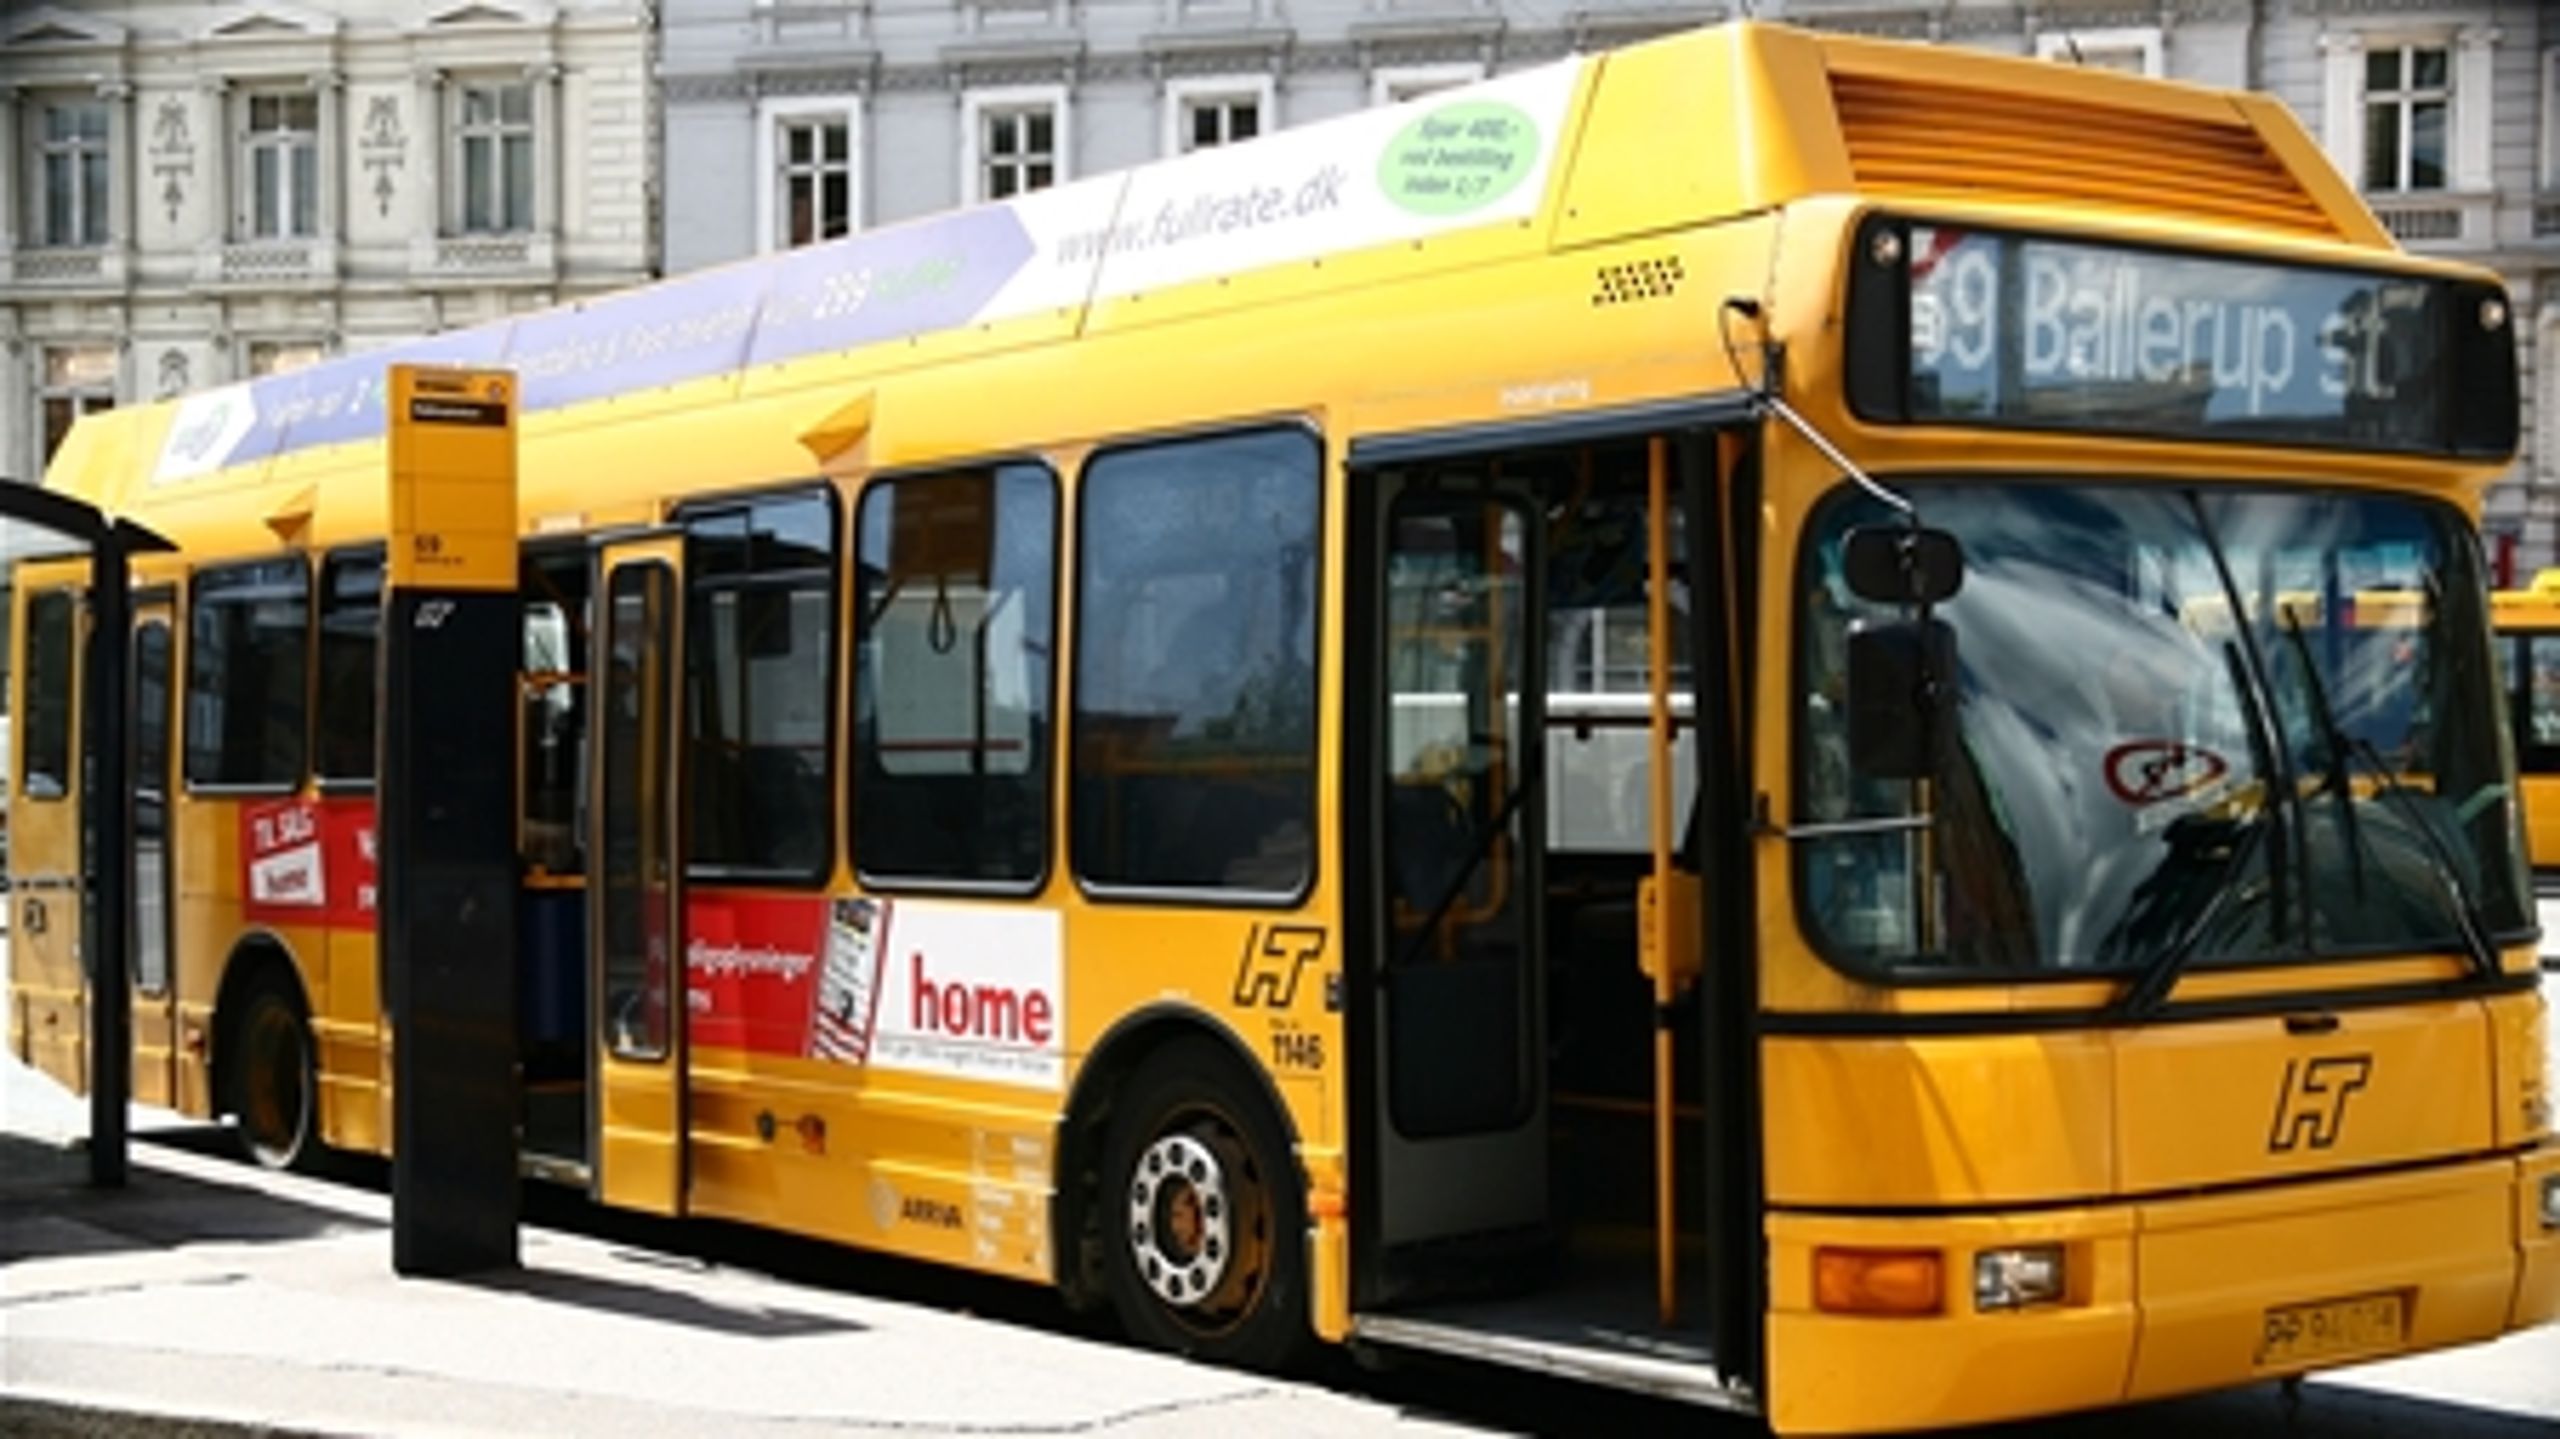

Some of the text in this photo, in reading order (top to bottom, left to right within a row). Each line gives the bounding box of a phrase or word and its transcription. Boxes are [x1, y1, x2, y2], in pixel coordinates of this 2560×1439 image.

[1058, 163, 1347, 267] www.fullrate.dk
[2024, 256, 2297, 416] Ballerup
[911, 952, 1051, 1044] home
[1272, 1033, 1325, 1070] 1146
